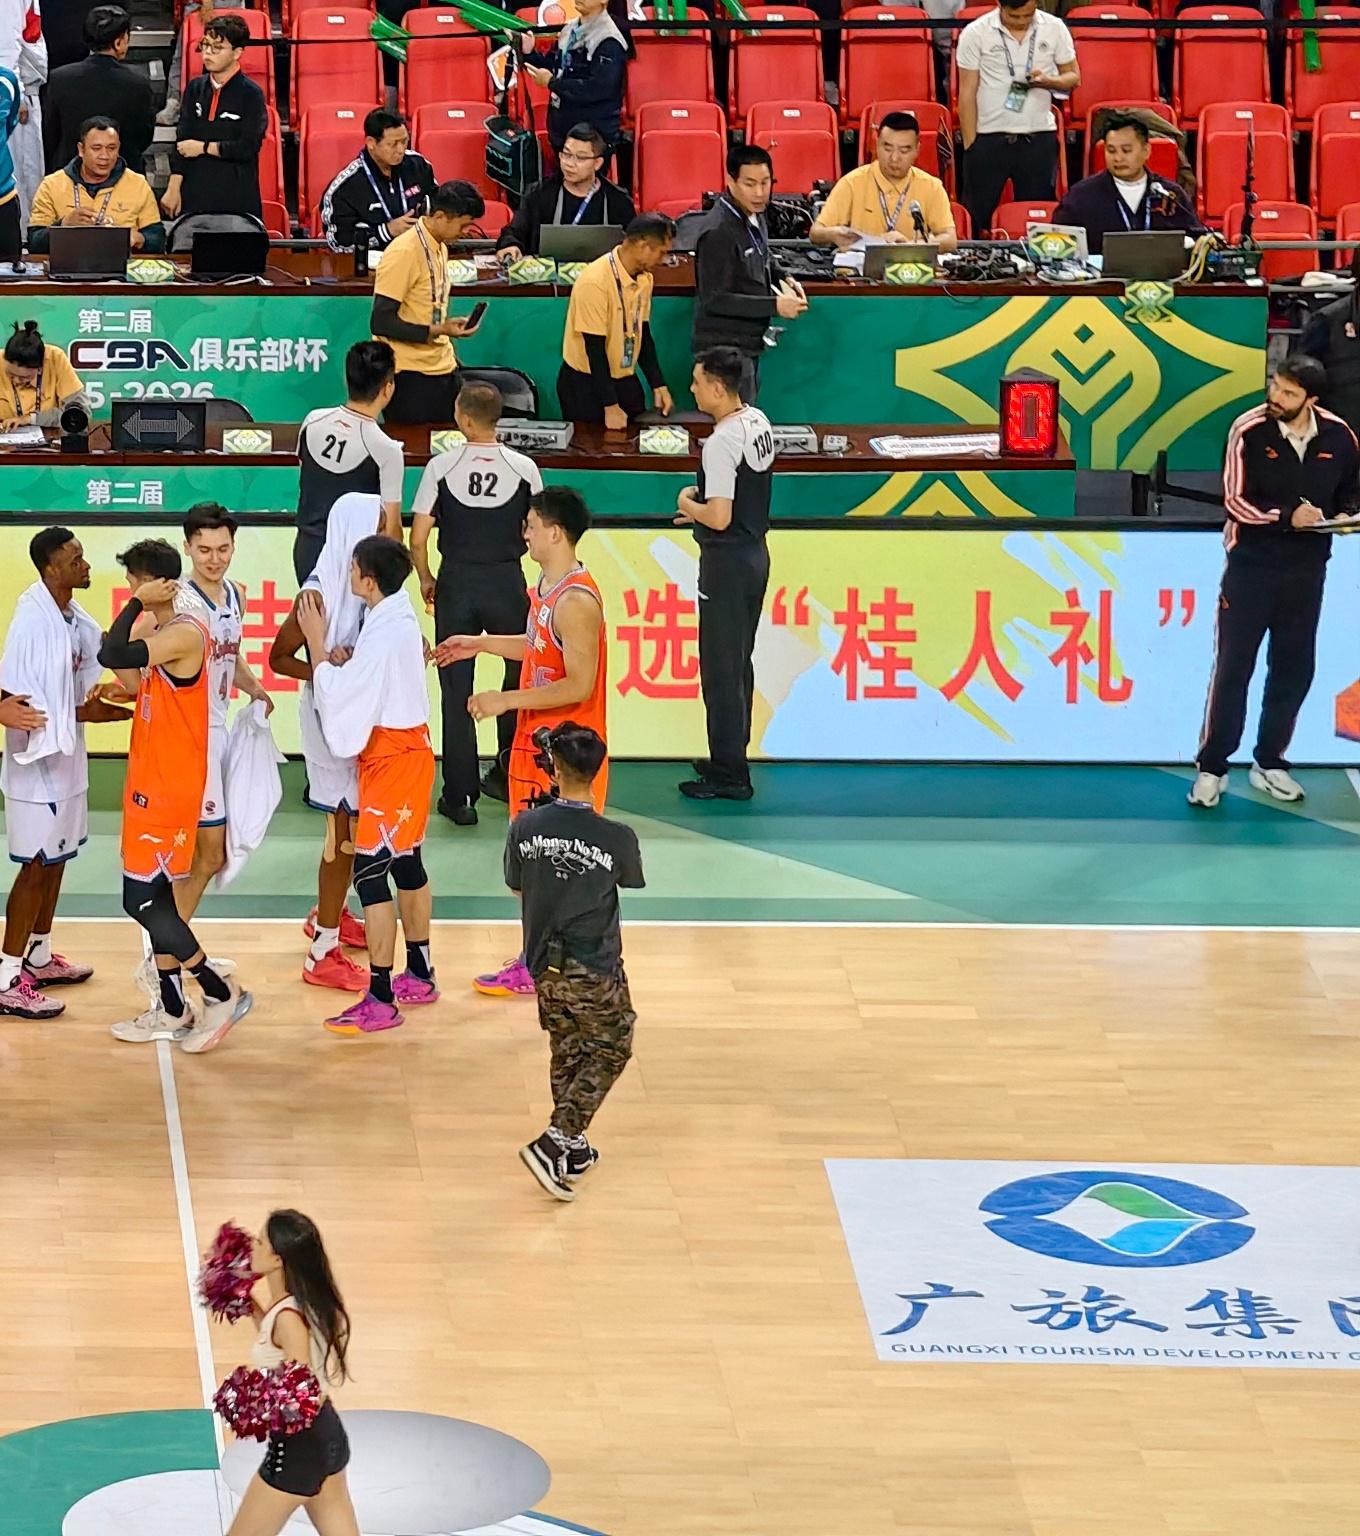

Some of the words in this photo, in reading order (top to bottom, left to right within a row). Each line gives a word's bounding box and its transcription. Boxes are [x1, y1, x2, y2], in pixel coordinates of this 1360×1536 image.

[77, 309, 153, 333] 第二届
[68, 338, 189, 371] CBA
[190, 336, 329, 373] 俱乐部杯
[1008, 383, 1050, 450] 0
[321, 434, 347, 464] 21
[752, 430, 772, 462] 130
[86, 479, 164, 506] 第二届
[468, 471, 498, 498] 82
[574, 839, 592, 857] No
[592, 846, 614, 872] Talk
[891, 1343, 1007, 1358] GUANGXI
[1014, 1344, 1135, 1359] TOURISM
[1144, 1347, 1341, 1363] DEVELOPMENT
